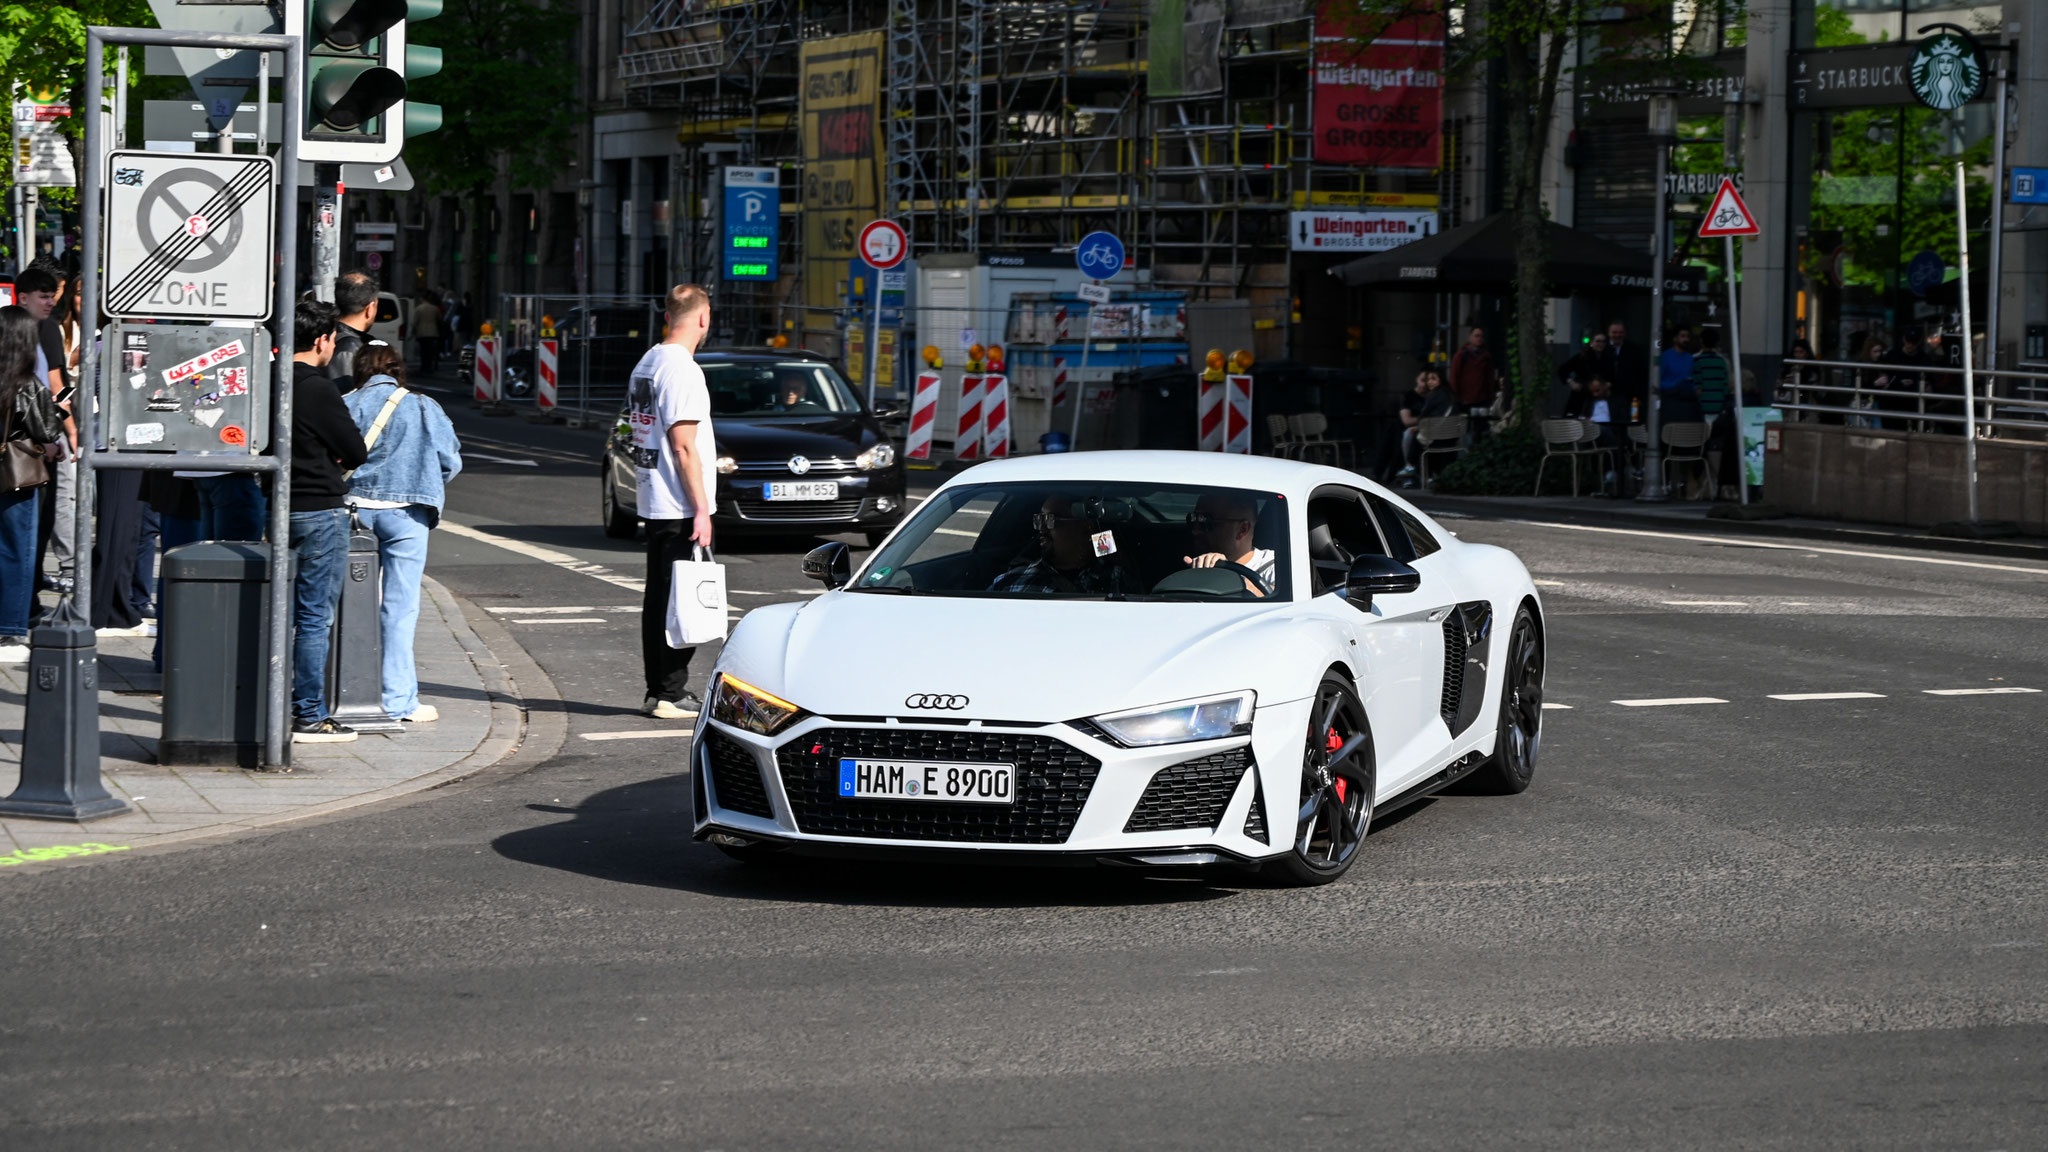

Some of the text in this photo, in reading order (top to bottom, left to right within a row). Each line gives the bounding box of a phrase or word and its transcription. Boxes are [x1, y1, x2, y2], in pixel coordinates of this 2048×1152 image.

[1317, 62, 1438, 91] Weingarten
[1817, 66, 1905, 92] STARBUCK
[17, 107, 33, 120] 12
[1337, 104, 1421, 123] GROSSE
[745, 197, 762, 222] P
[1314, 217, 1406, 236] Weingarten
[1323, 237, 1364, 246] GROSSE
[1610, 274, 1690, 291] STARBCKS
[148, 281, 228, 307] ZONE
[1083, 287, 1105, 298] Ende
[773, 483, 836, 497] BI MM 852
[856, 764, 1009, 798] HAM E 8900
